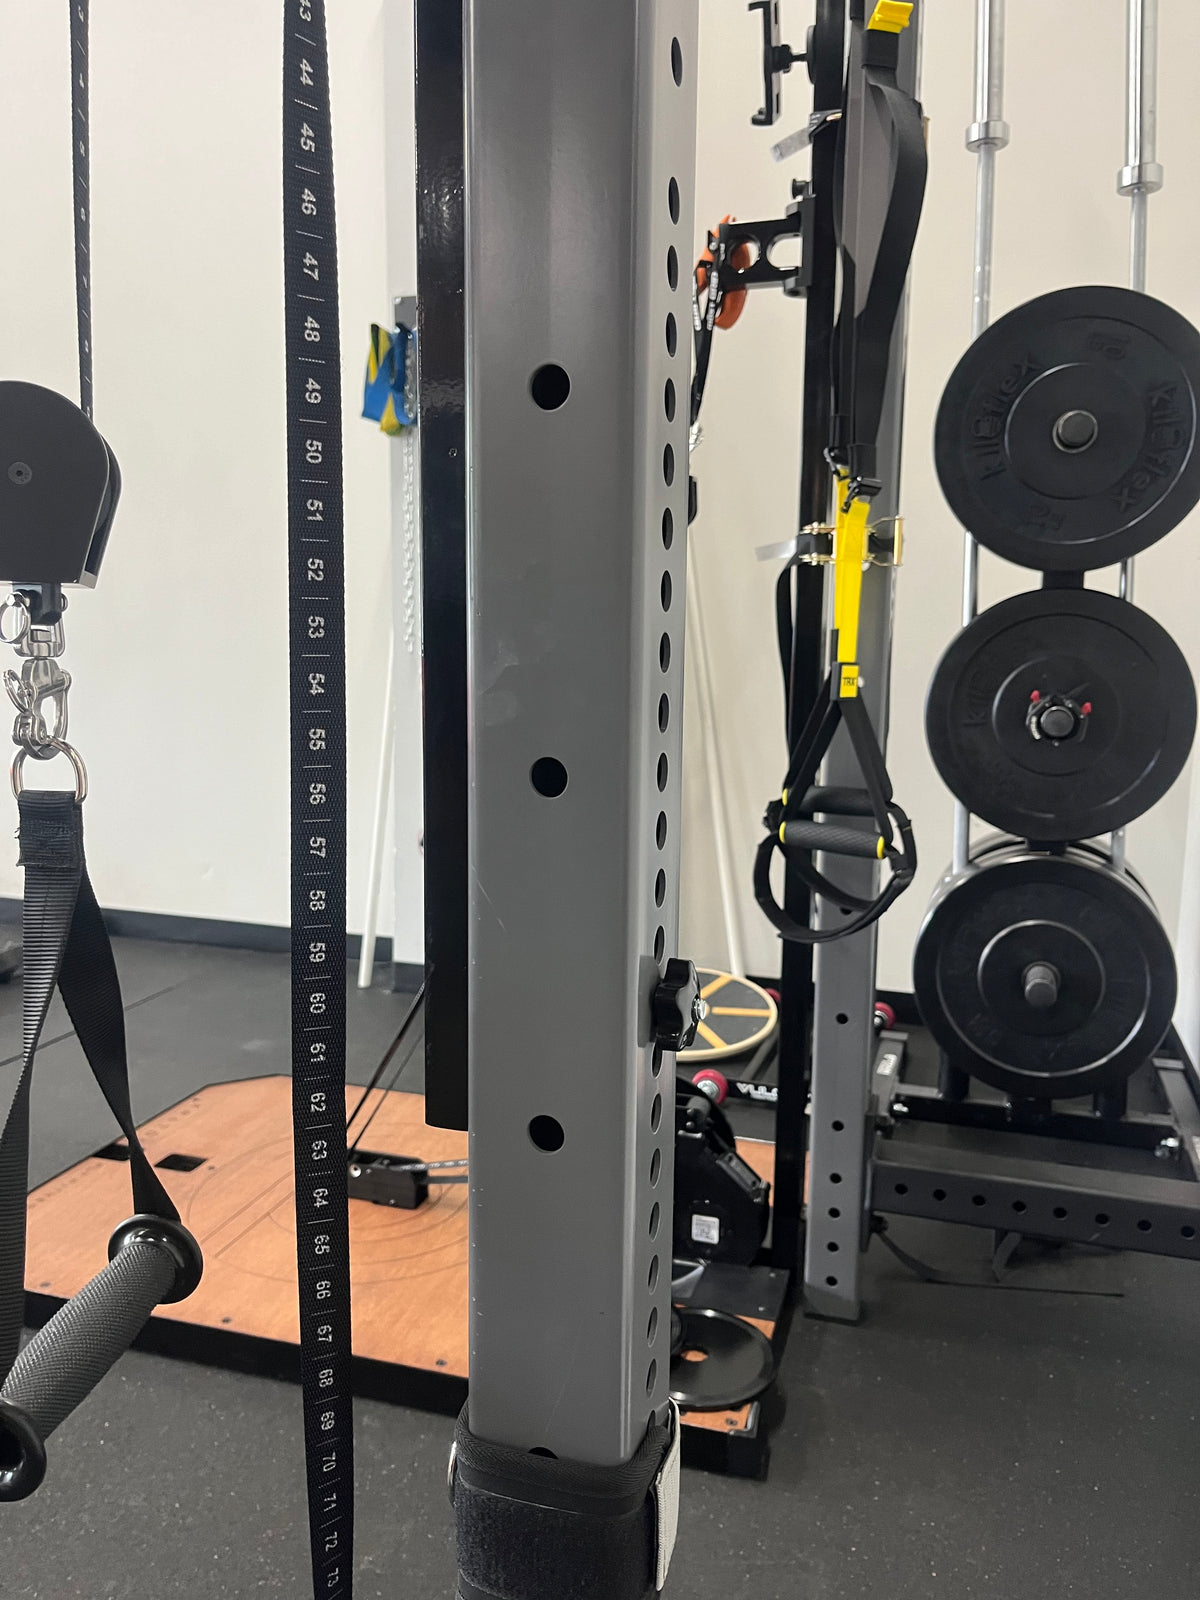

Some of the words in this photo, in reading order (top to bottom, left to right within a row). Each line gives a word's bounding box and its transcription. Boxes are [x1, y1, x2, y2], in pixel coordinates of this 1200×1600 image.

[299, 58, 314, 86] 44
[300, 122, 316, 153] 45
[301, 188, 317, 216] 46
[302, 251, 319, 281] 47
[304, 315, 321, 342] 48
[305, 377, 322, 404] 49
[305, 439, 323, 464] 50
[306, 499, 324, 521] 51
[307, 558, 324, 581] 52
[308, 615, 325, 639] 53
[308, 672, 325, 696] 54
[842, 677, 857, 687] TRX
[308, 728, 326, 751] 55
[309, 782, 327, 805] 56
[309, 836, 327, 859] 57
[309, 890, 326, 911] 58
[308, 942, 326, 963] 59
[309, 992, 326, 1014] 60
[310, 1042, 326, 1062] 61
[310, 1092, 327, 1112] 62
[311, 1140, 328, 1160] 63
[313, 1188, 329, 1208] 64
[314, 1234, 330, 1255] 65
[316, 1280, 331, 1300] 66
[317, 1324, 333, 1342] 67
[319, 1368, 334, 1388] 68
[320, 1411, 335, 1431] 69
[322, 1451, 336, 1472] 70
[323, 1492, 337, 1512] 71
[324, 1531, 338, 1552] 72
[327, 1567, 339, 1588] 73
